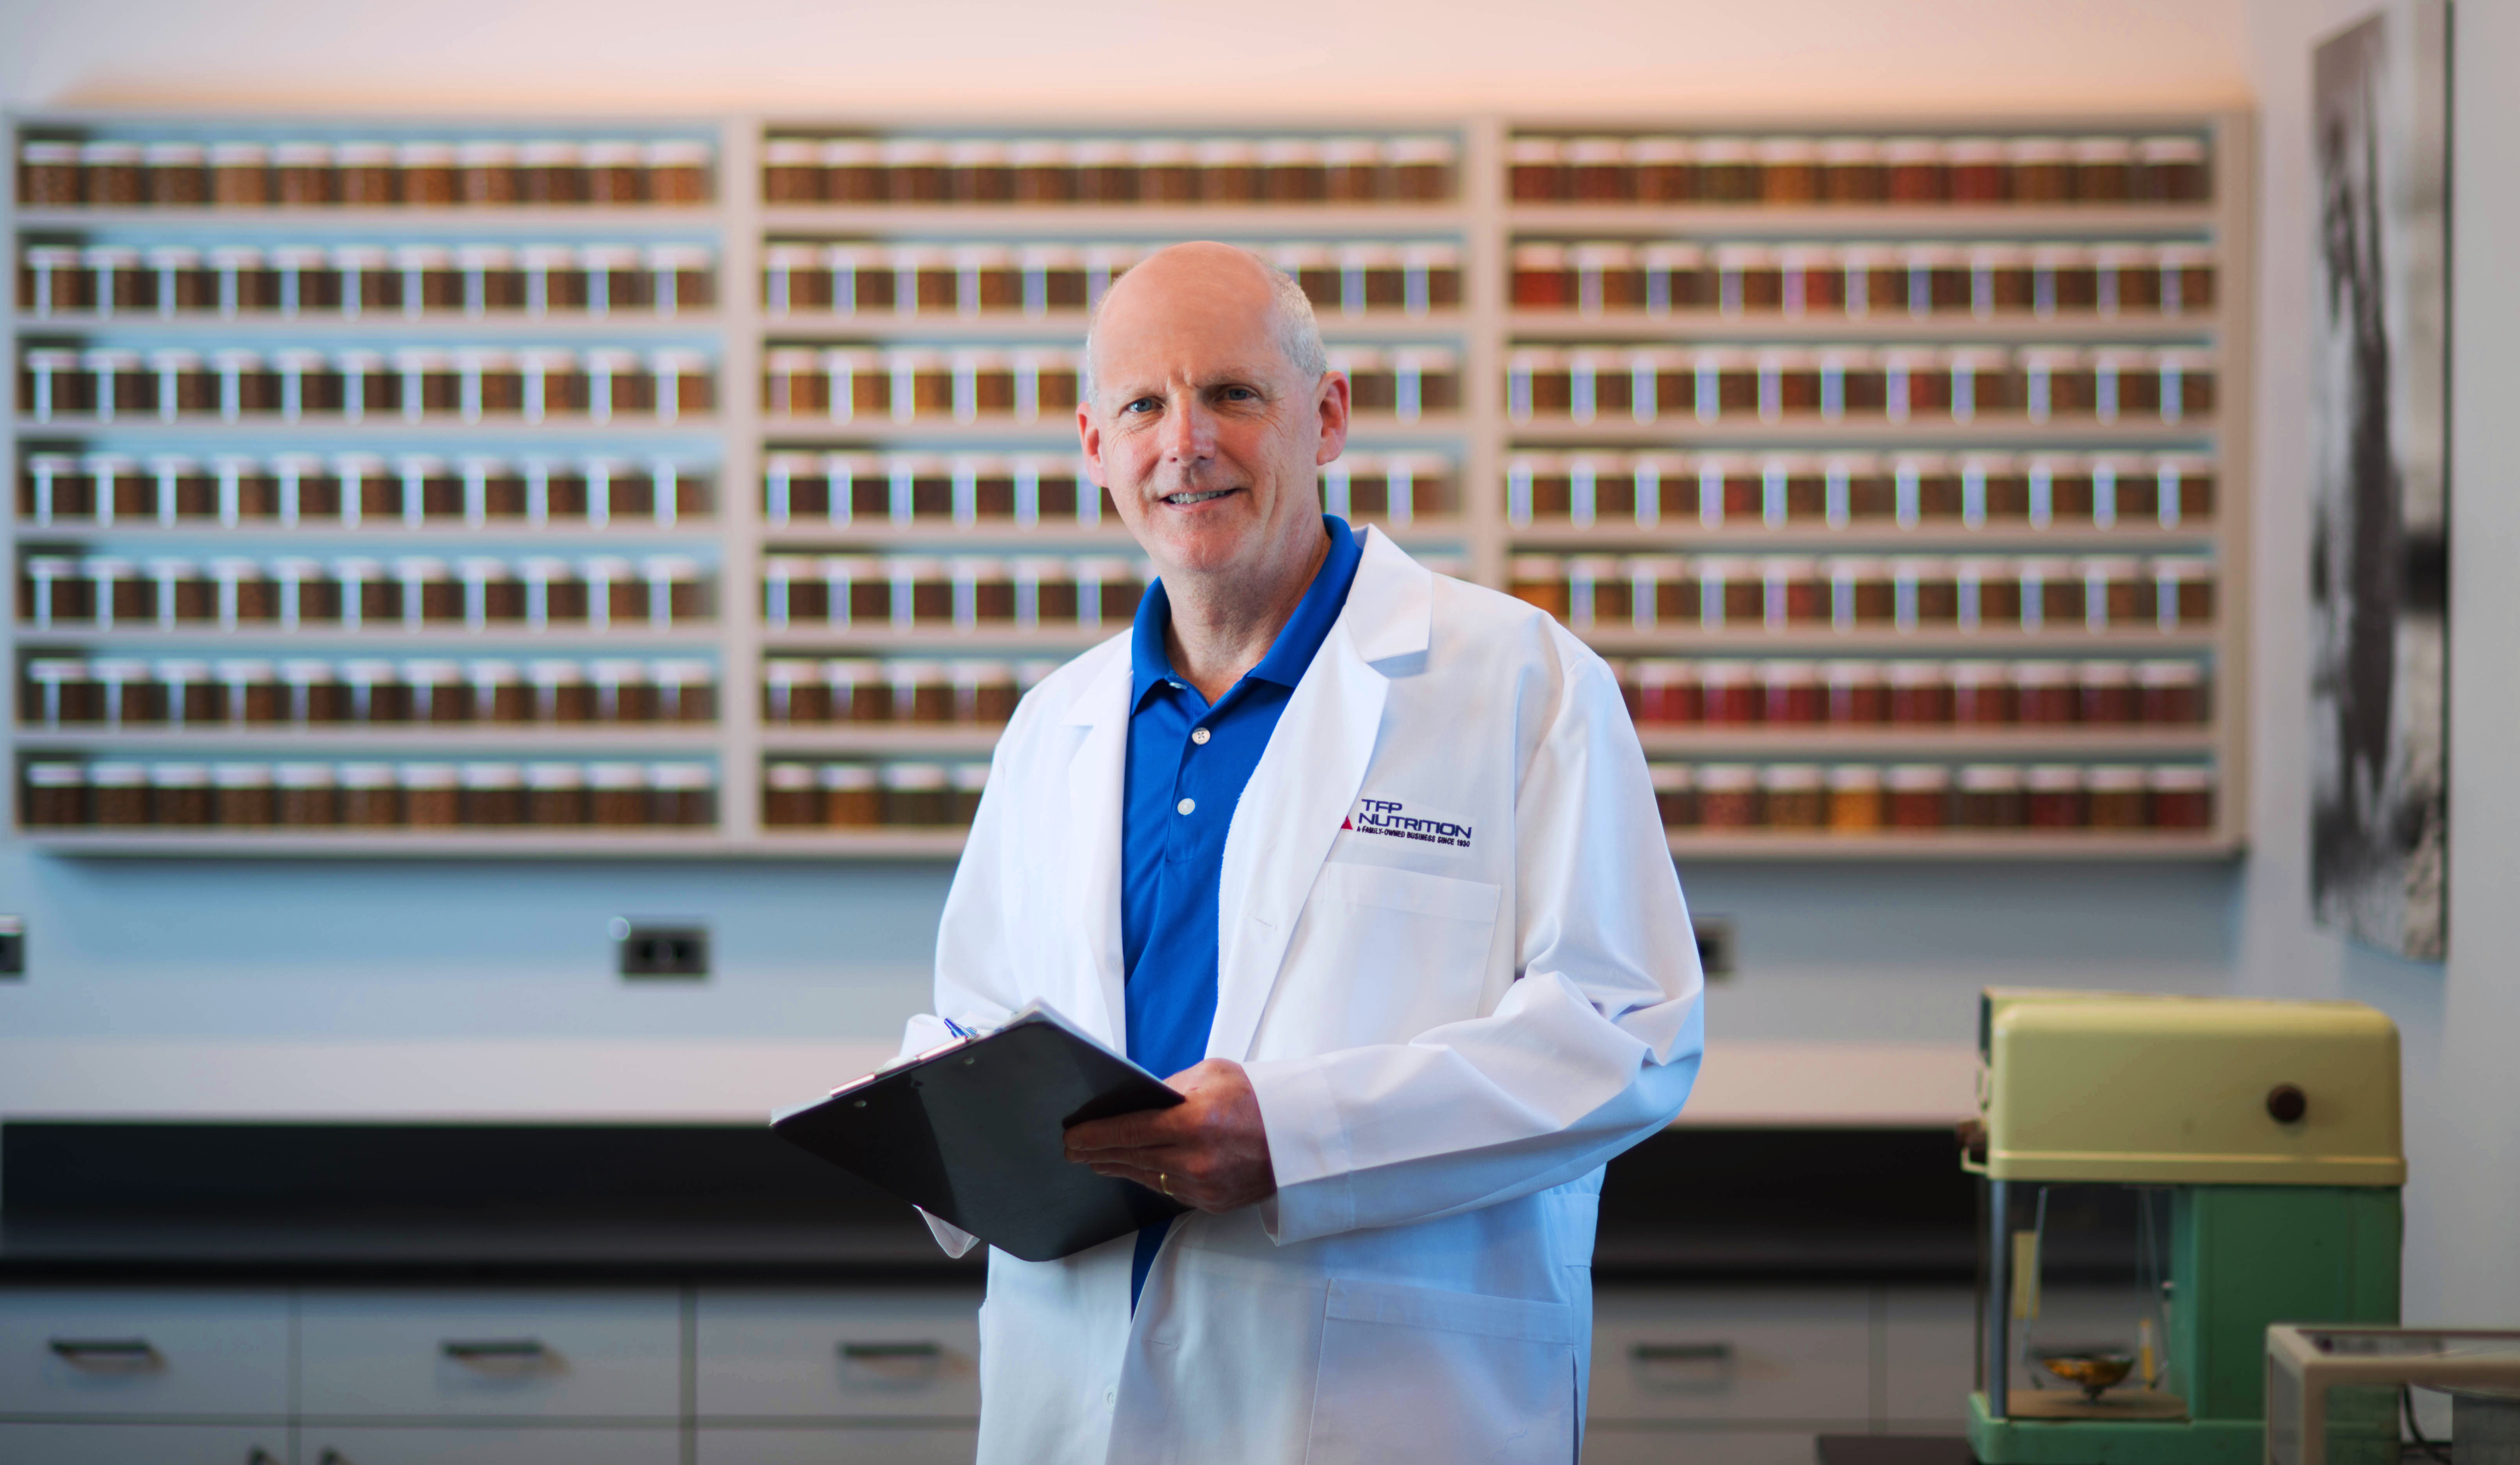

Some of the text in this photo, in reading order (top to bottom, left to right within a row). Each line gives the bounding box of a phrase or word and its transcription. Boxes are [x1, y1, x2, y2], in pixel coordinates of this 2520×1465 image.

[1361, 799, 1402, 813] TFP
[1359, 813, 1472, 839] NUTRITION
[1362, 826, 1405, 837] FAMILY-OWNED
[1407, 832, 1435, 842] BUSINESS
[1437, 836, 1454, 845] SINCE
